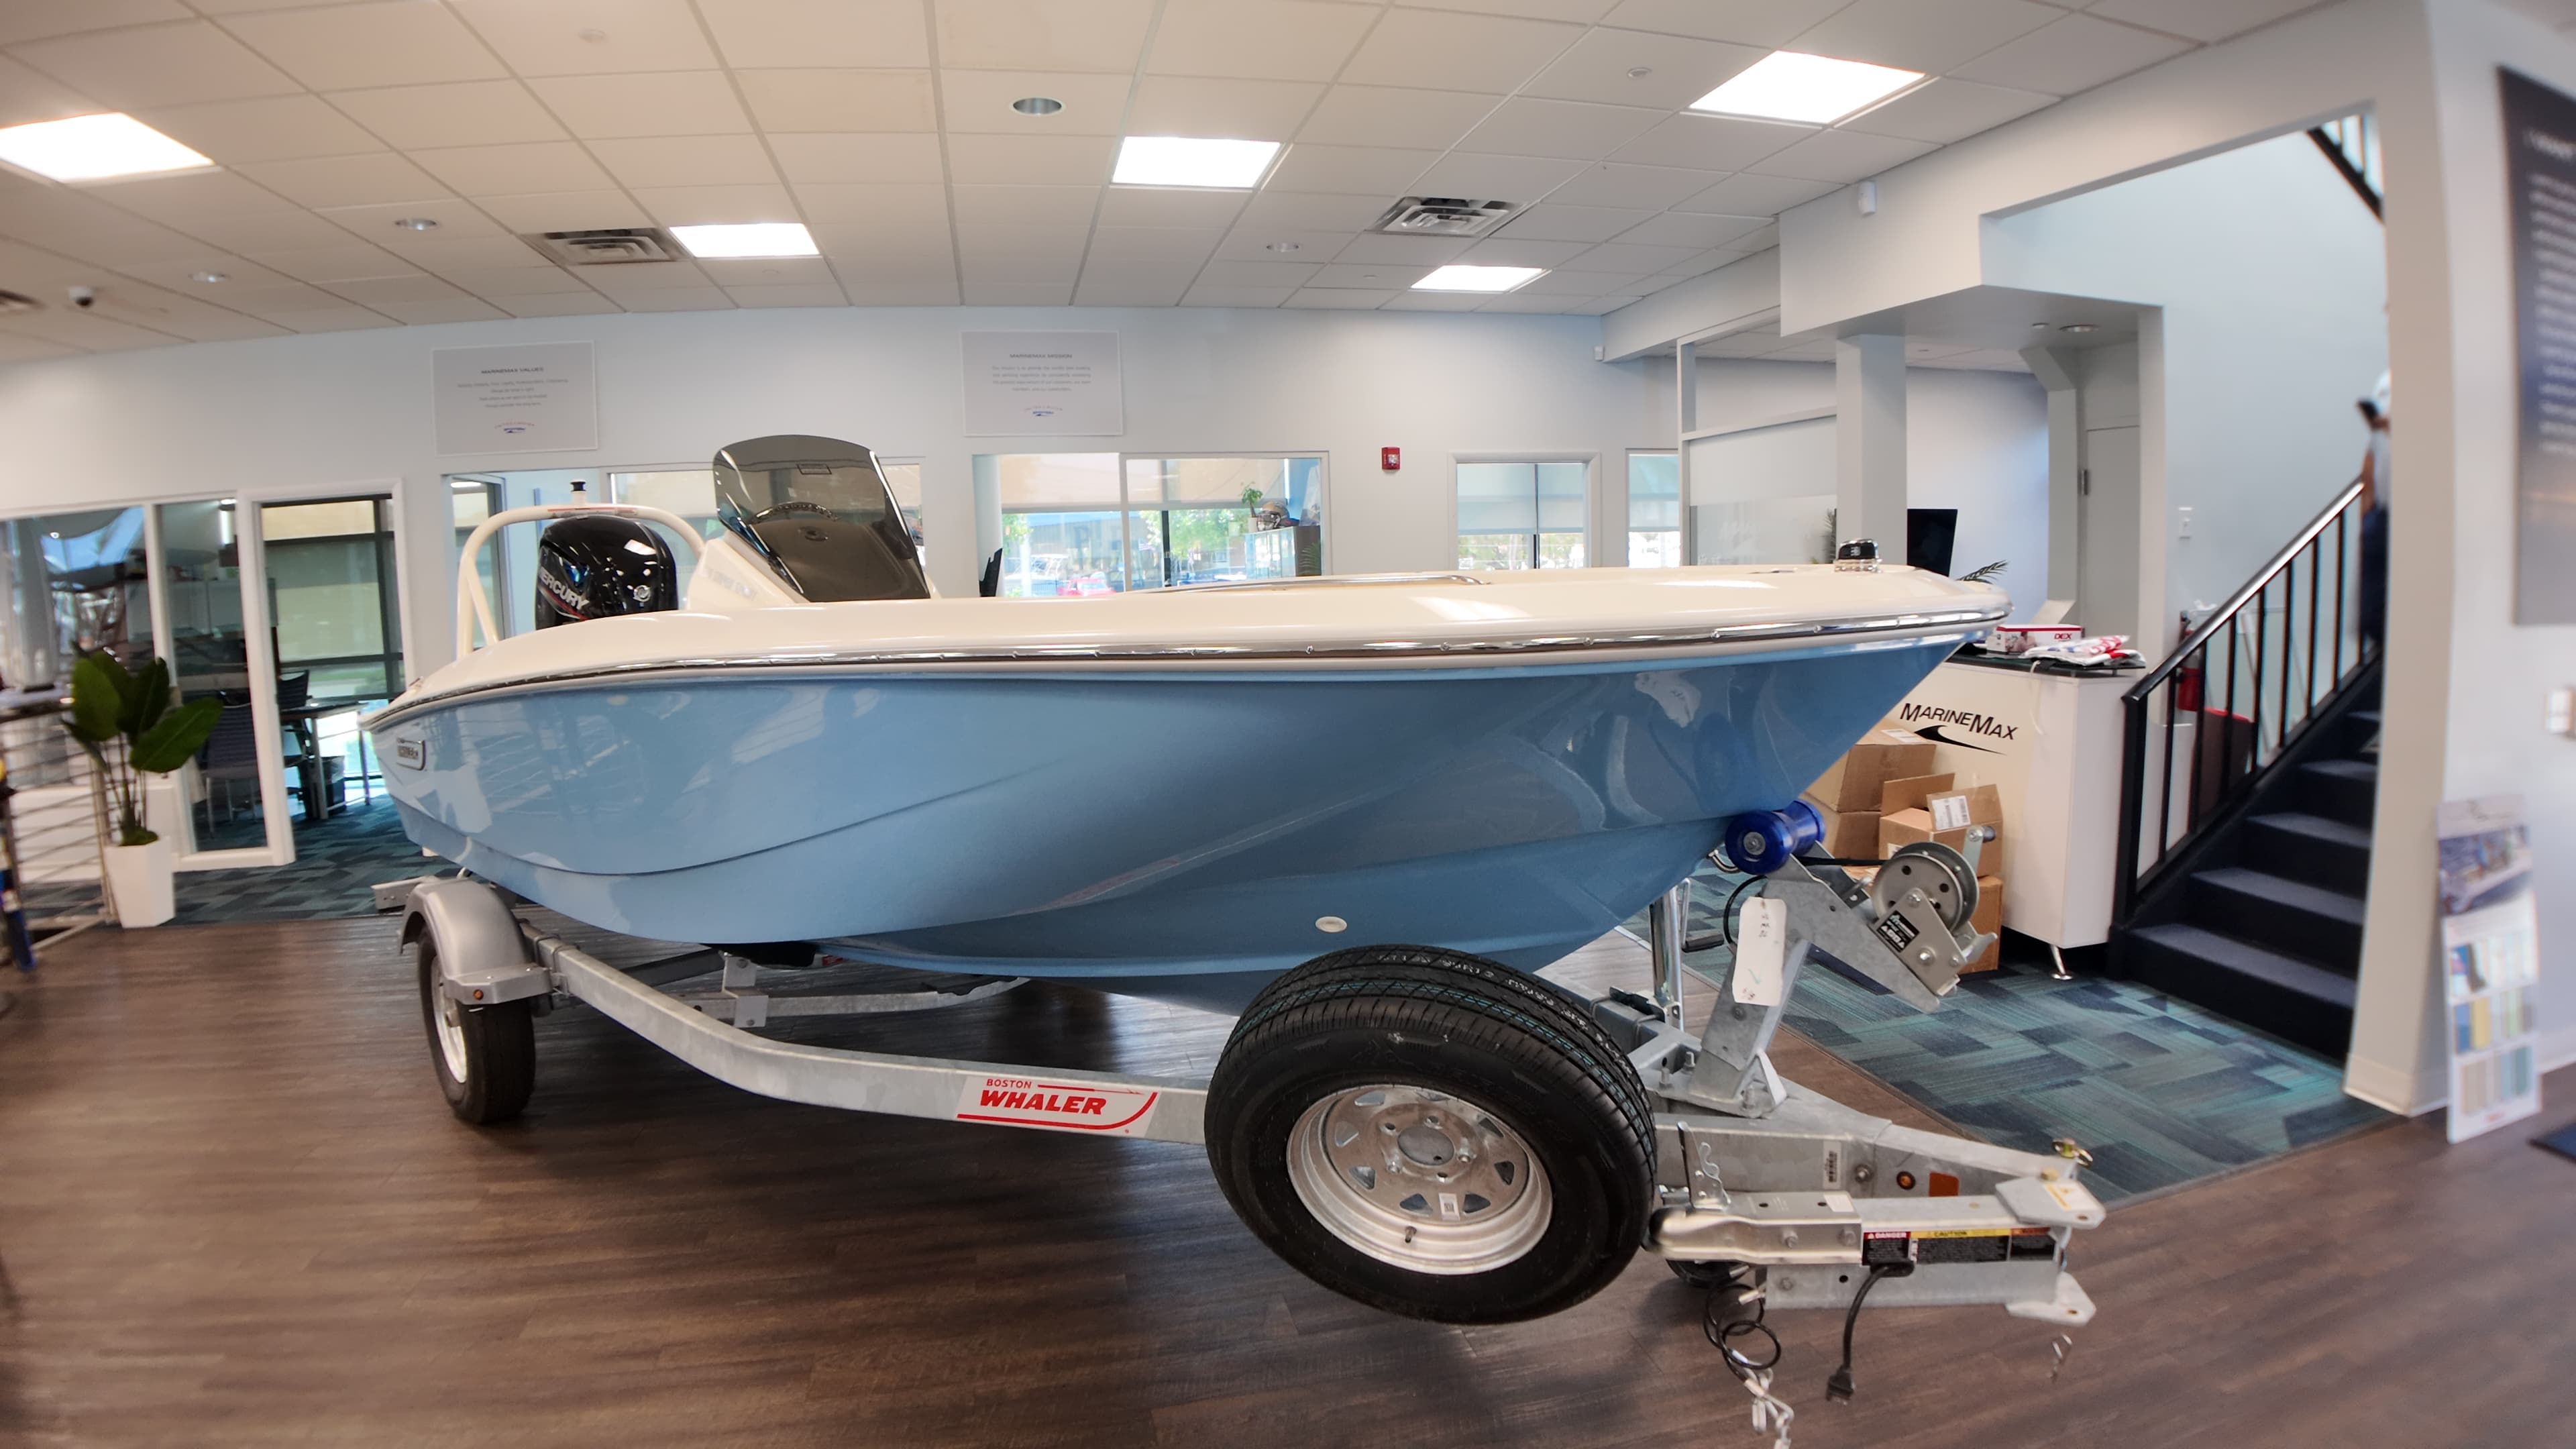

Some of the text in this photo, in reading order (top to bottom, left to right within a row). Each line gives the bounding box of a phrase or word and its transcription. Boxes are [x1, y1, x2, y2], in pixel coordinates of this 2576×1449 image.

[539, 566, 590, 610] ERCURY
[986, 1079, 1032, 1089] BOSTON
[980, 1090, 1107, 1116] WHALER
